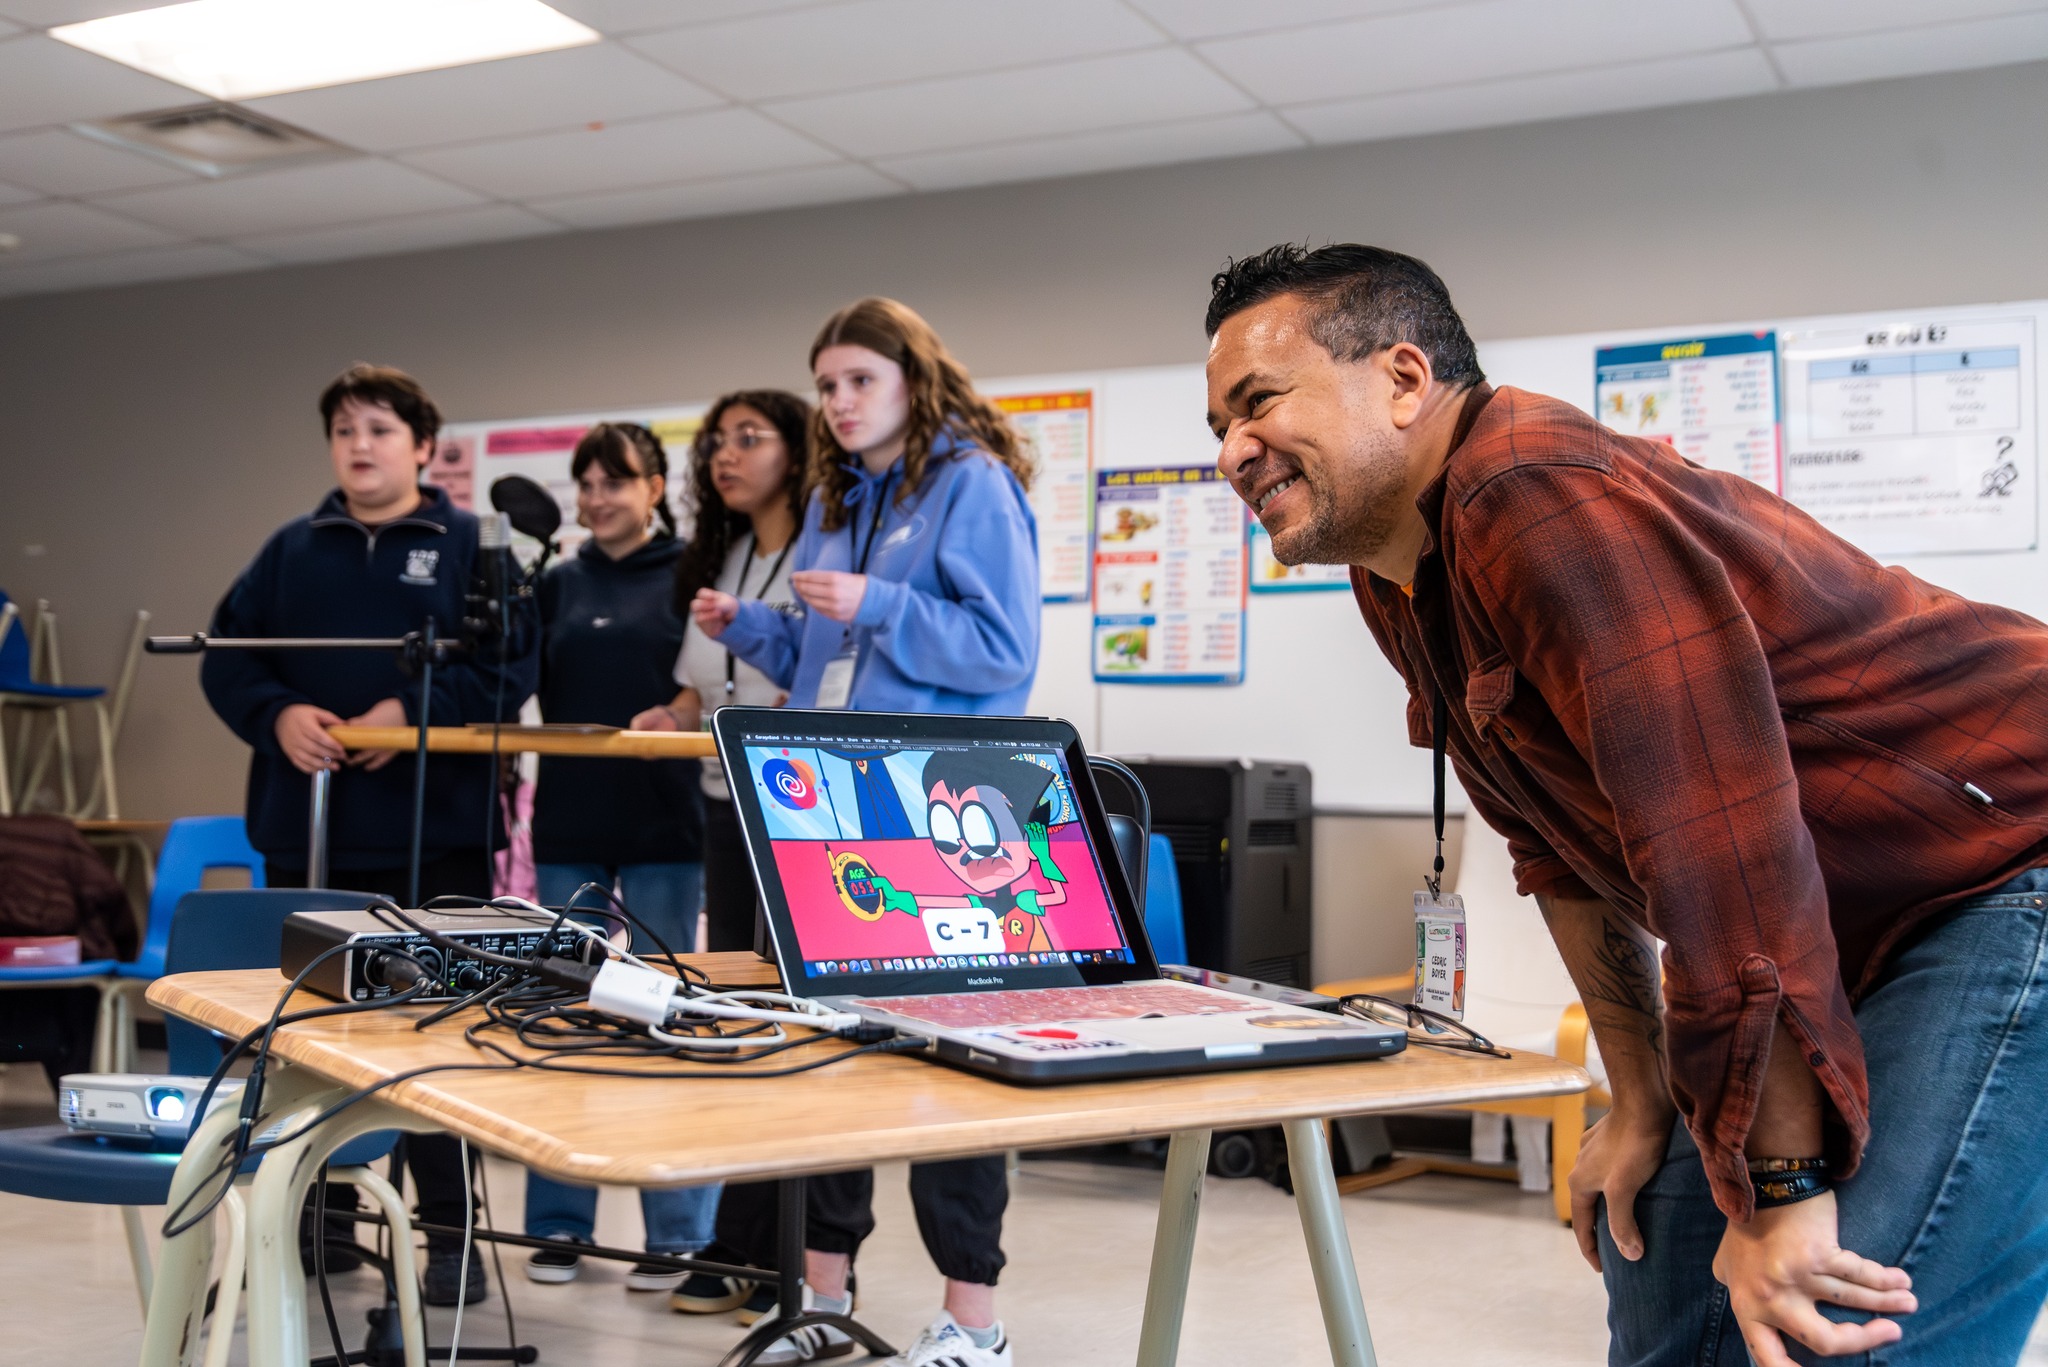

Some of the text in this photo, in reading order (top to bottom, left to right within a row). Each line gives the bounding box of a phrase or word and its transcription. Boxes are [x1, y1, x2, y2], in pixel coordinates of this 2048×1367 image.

[849, 867, 867, 880] AGE
[936, 922, 954, 941] C
[976, 921, 990, 940] 7
[1431, 968, 1447, 980] BOYER
[967, 976, 1004, 985] MacBook Pro
